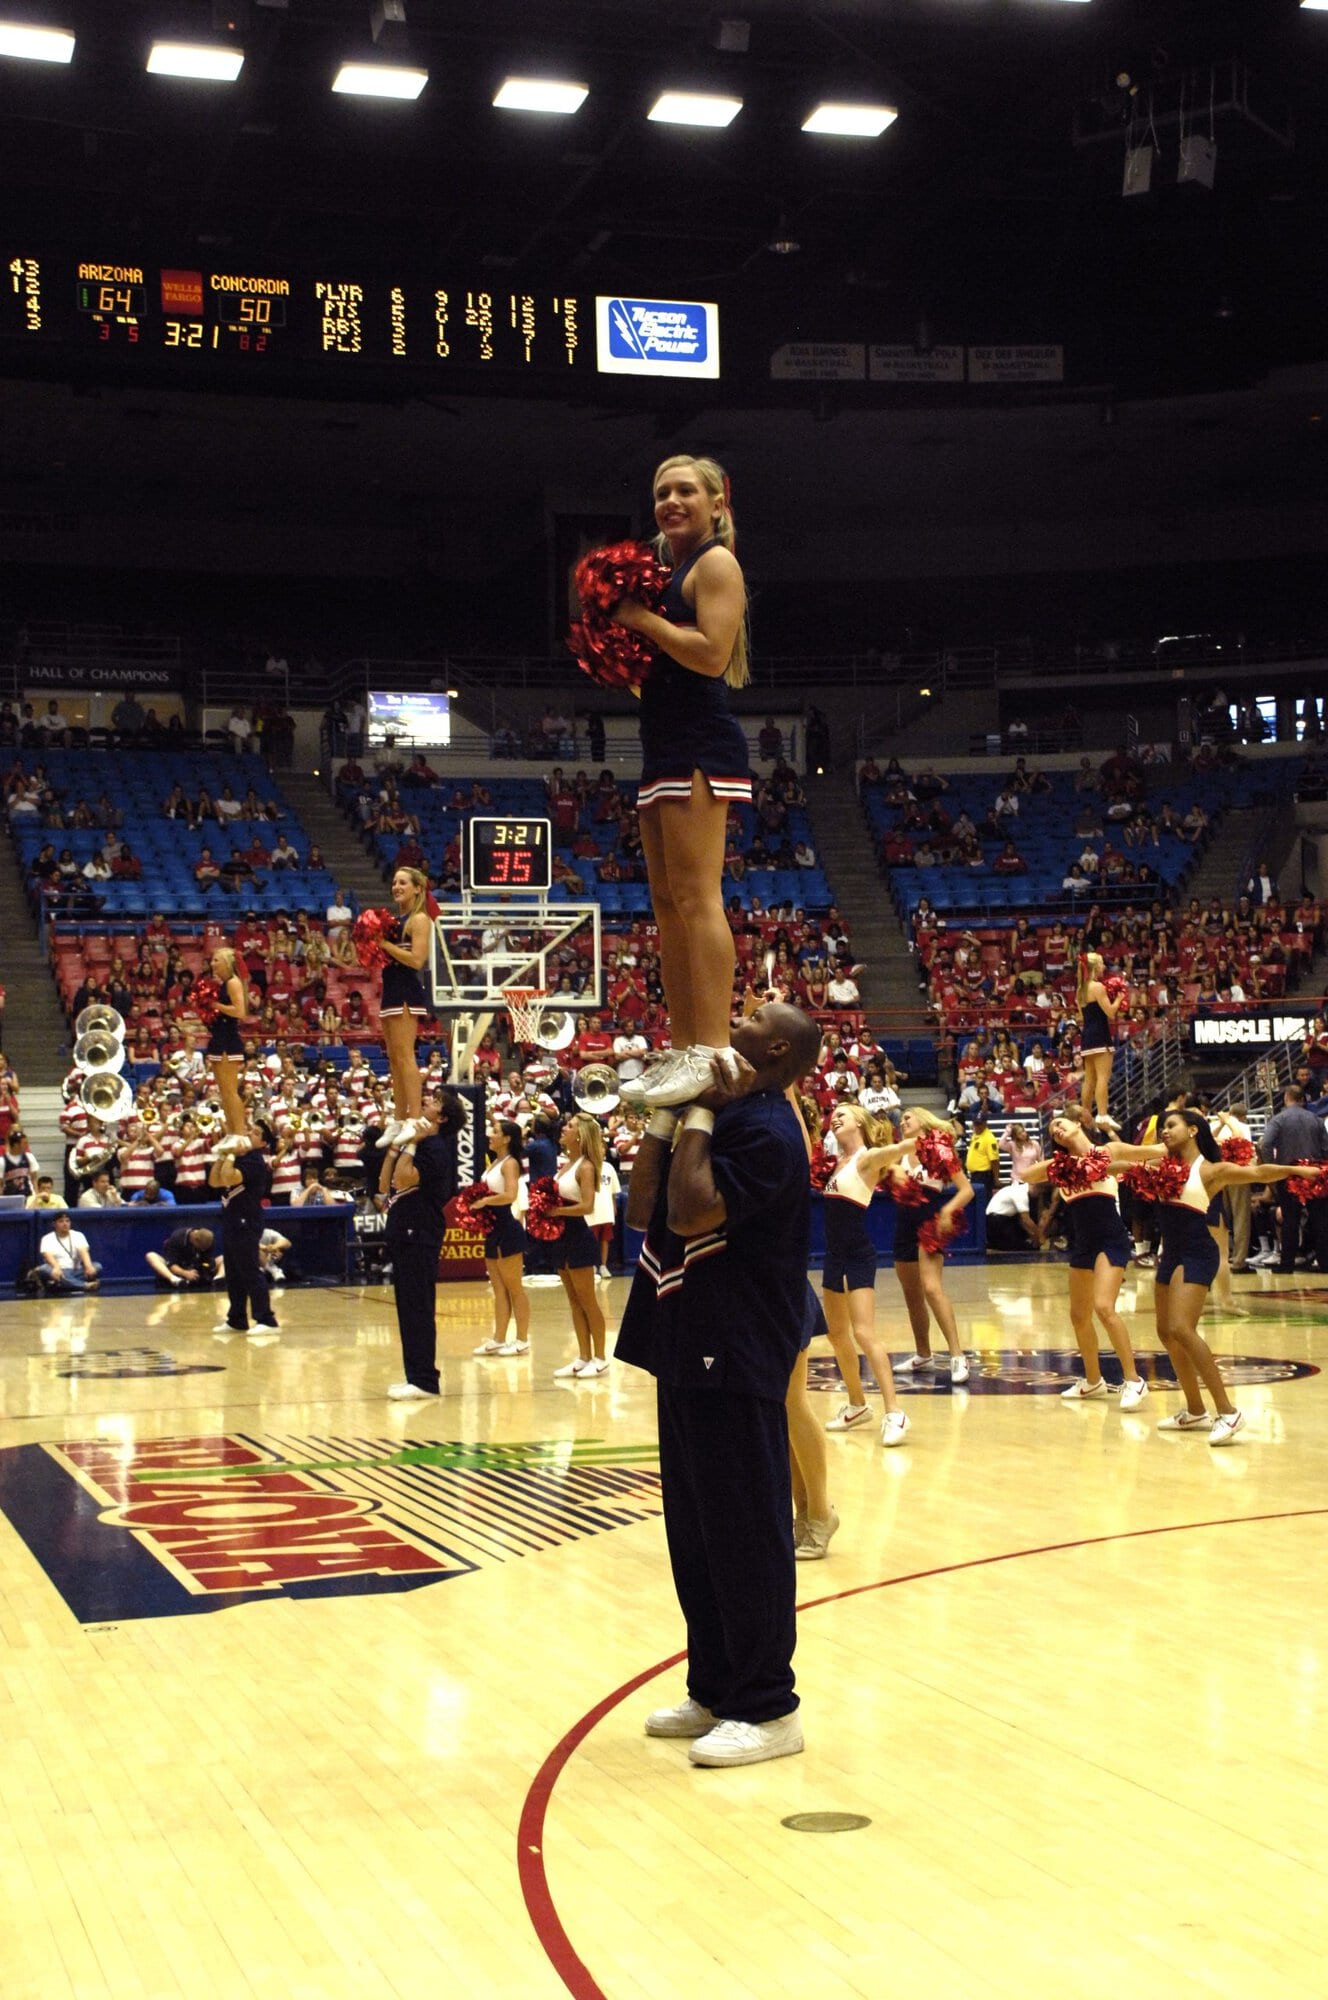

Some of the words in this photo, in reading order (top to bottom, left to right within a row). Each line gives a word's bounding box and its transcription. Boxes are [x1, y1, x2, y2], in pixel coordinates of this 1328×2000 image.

[78, 263, 144, 284] ARIZONA
[162, 282, 202, 293] WELLS
[210, 274, 290, 295] CONCORDIA
[99, 286, 132, 313] 64
[164, 292, 202, 302] FARGO
[315, 282, 363, 302] PLYR
[467, 291, 492, 309] 10
[554, 298, 577, 315] 15
[240, 298, 271, 323] 50
[324, 300, 358, 318] PTS
[631, 307, 688, 325] Tucson
[164, 321, 220, 349] 3:21
[322, 317, 361, 336] RBS
[638, 321, 699, 340] Electric
[323, 334, 361, 353] FLS
[644, 337, 700, 354] Power
[30, 666, 64, 679] HALL
[69, 668, 85, 679] OF
[90, 669, 171, 682] CHAMPIONS
[494, 825, 542, 845] 3:21
[490, 851, 532, 882] 35
[207, 926, 220, 937] 21
[645, 925, 658, 936] 22
[1194, 1019, 1271, 1043] MUSCLE
[353, 1213, 388, 1232] FSN
